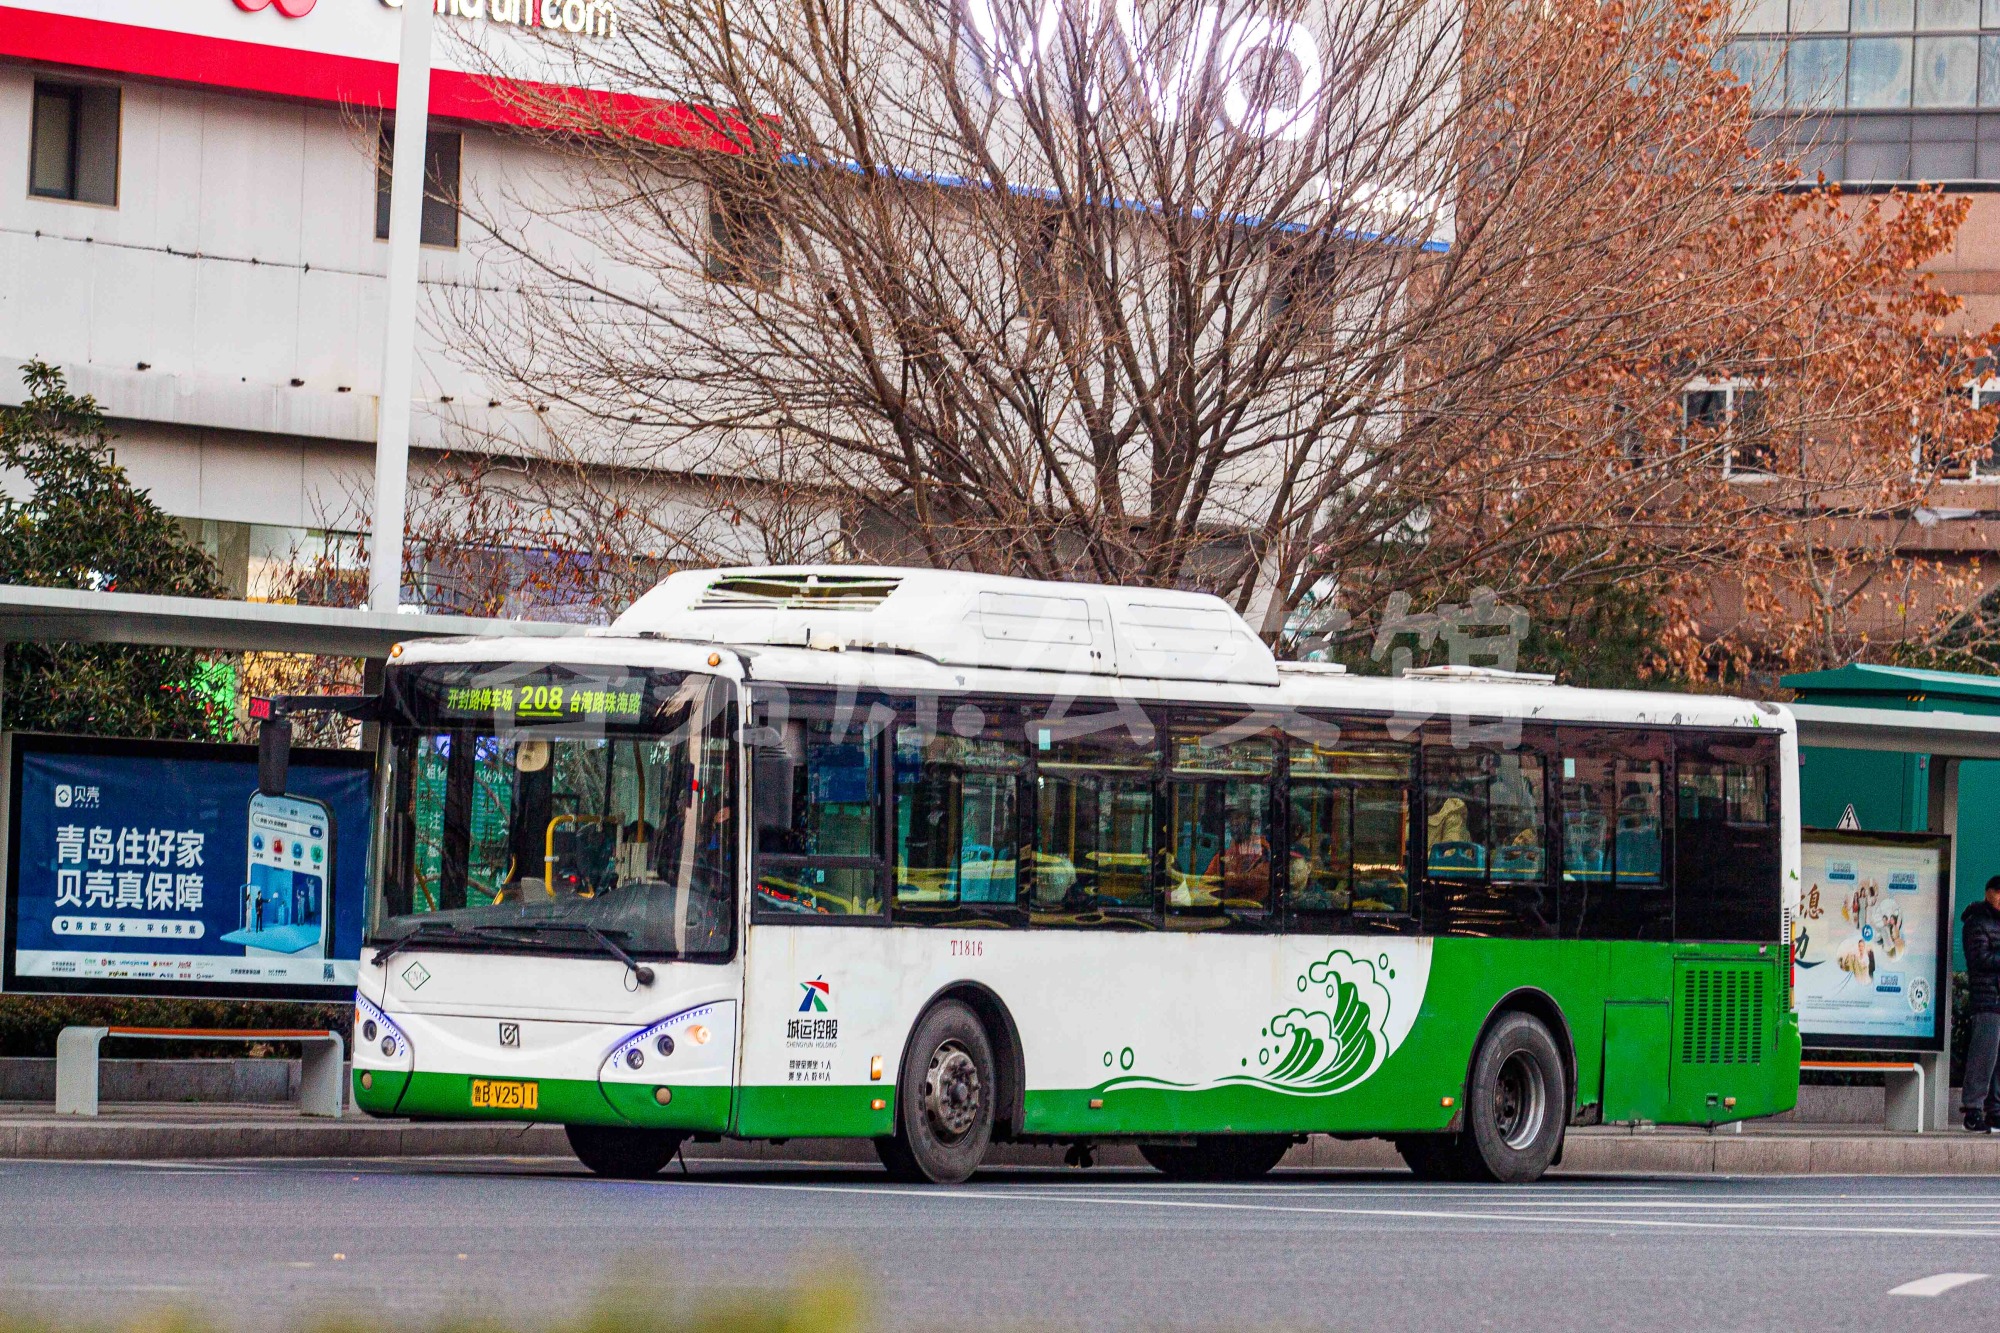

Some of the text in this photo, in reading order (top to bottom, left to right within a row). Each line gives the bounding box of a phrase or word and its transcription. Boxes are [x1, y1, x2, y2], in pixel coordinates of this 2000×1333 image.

[519, 685, 563, 710] 208
[250, 698, 270, 719] 208
[74, 785, 100, 803] 贝壳
[56, 824, 205, 868] 青岛住好家
[54, 869, 204, 912] 贝壳真保障
[950, 939, 983, 957] T1816
[787, 1018, 838, 1040] 城运控股
[786, 1041, 837, 1049] CHENGYUN HOLDING
